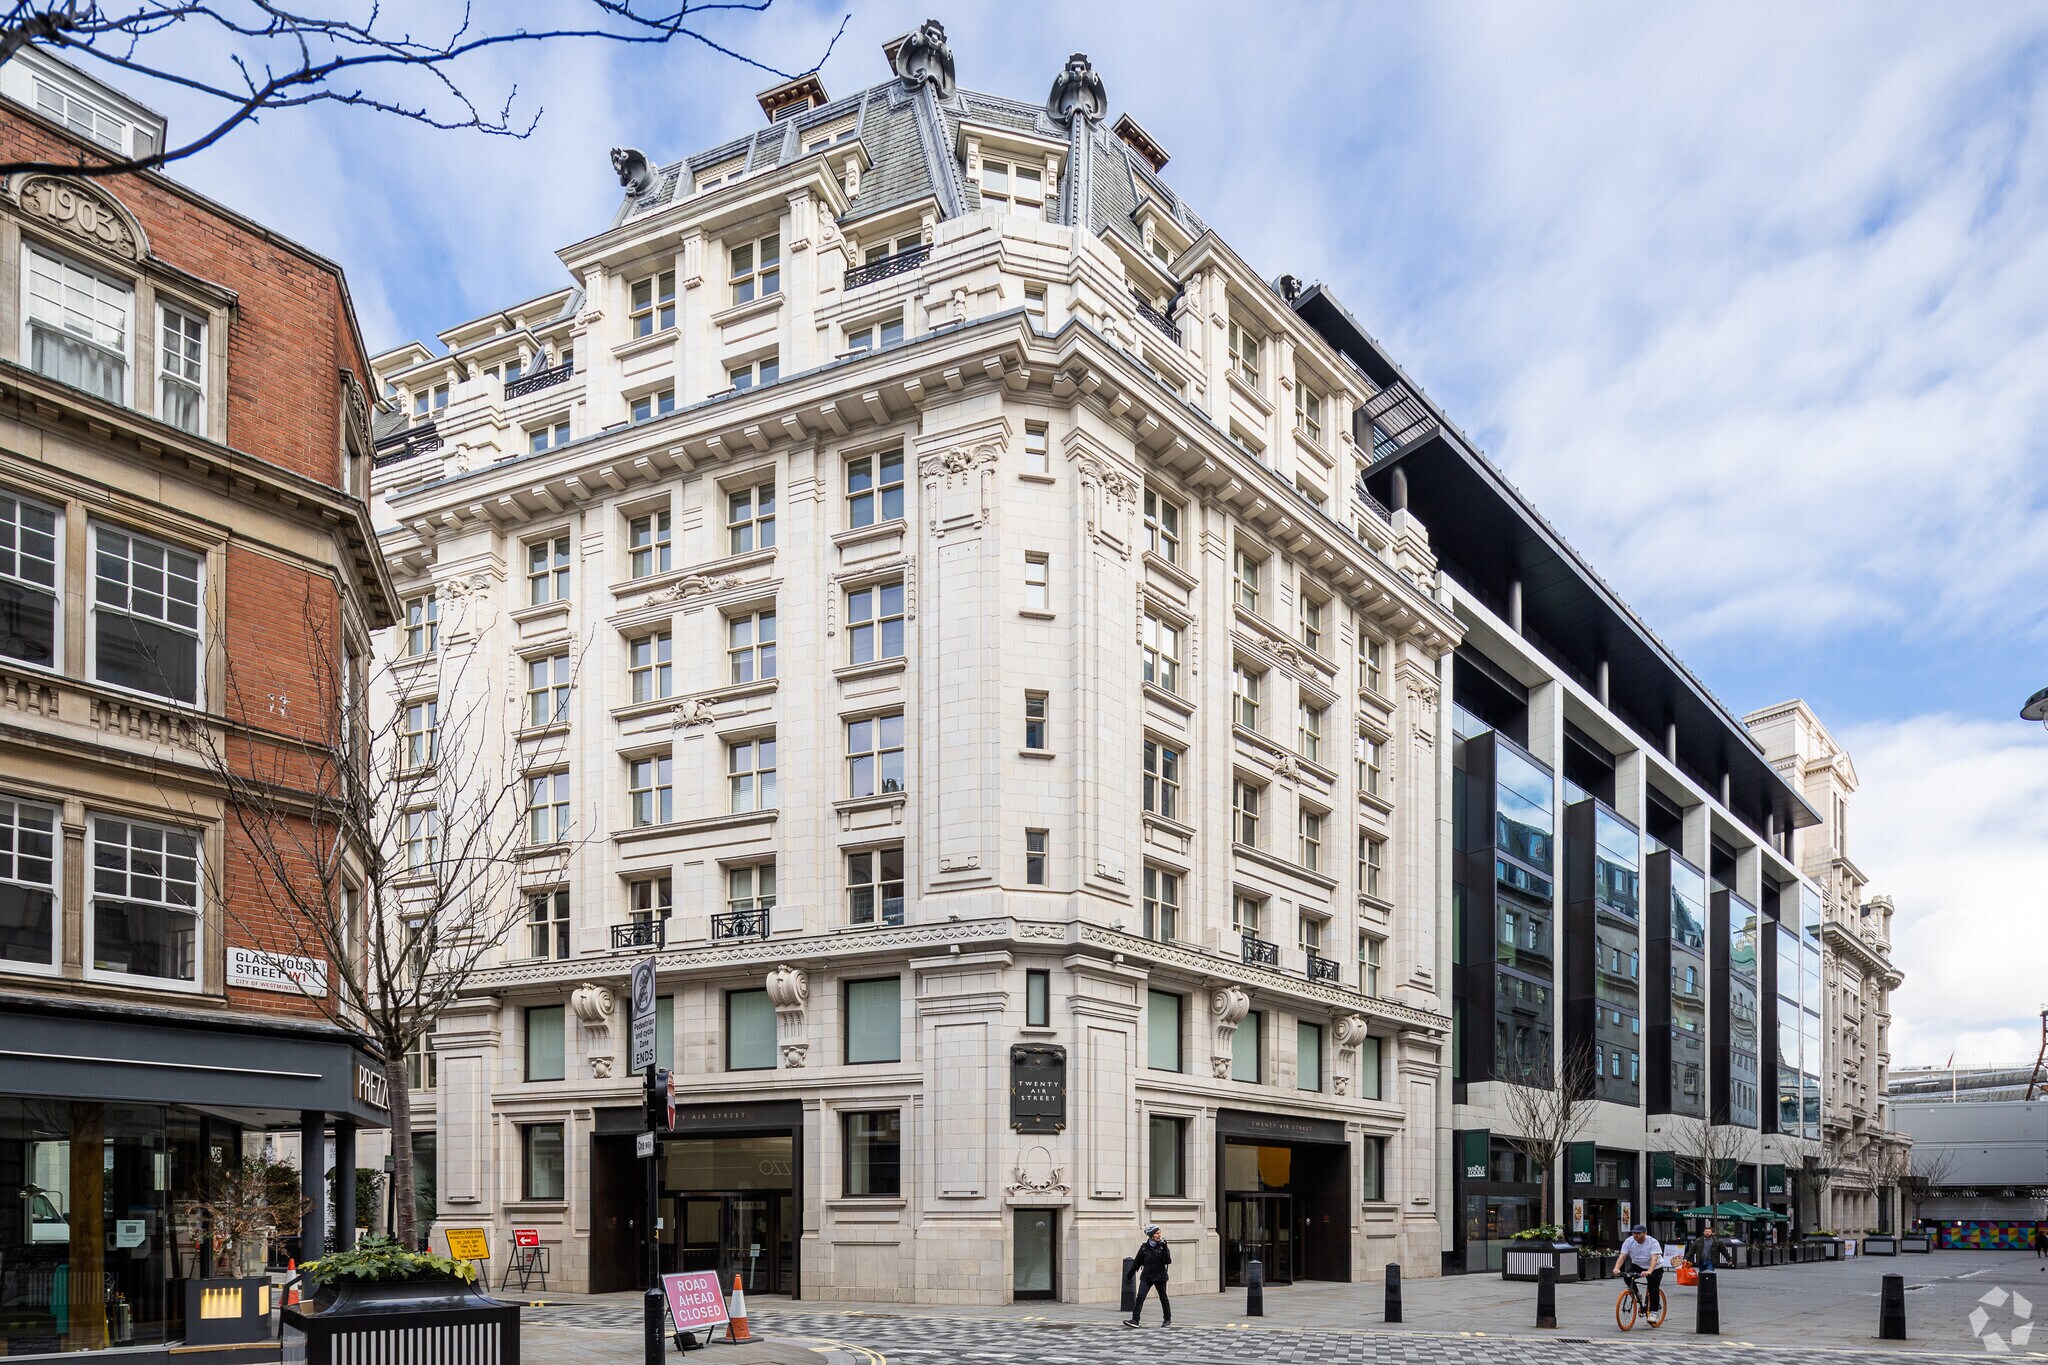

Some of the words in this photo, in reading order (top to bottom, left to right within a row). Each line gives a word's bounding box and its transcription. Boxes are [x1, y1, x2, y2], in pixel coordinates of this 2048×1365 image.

[46, 186, 117, 241] 1903
[235, 963, 282, 979] STREET
[289, 971, 306, 983] W1
[634, 1018, 654, 1031] Pedestrian
[643, 1027, 654, 1038] cycle
[639, 1039, 649, 1049] Zone
[636, 1048, 654, 1065] ENDS
[1251, 1120, 1276, 1128] TWENTY
[1291, 1124, 1312, 1132] STREET
[637, 1141, 645, 1151] One
[677, 1278, 708, 1292] ROAD
[679, 1291, 715, 1307] AHEAD
[679, 1304, 721, 1322] CLOSED
